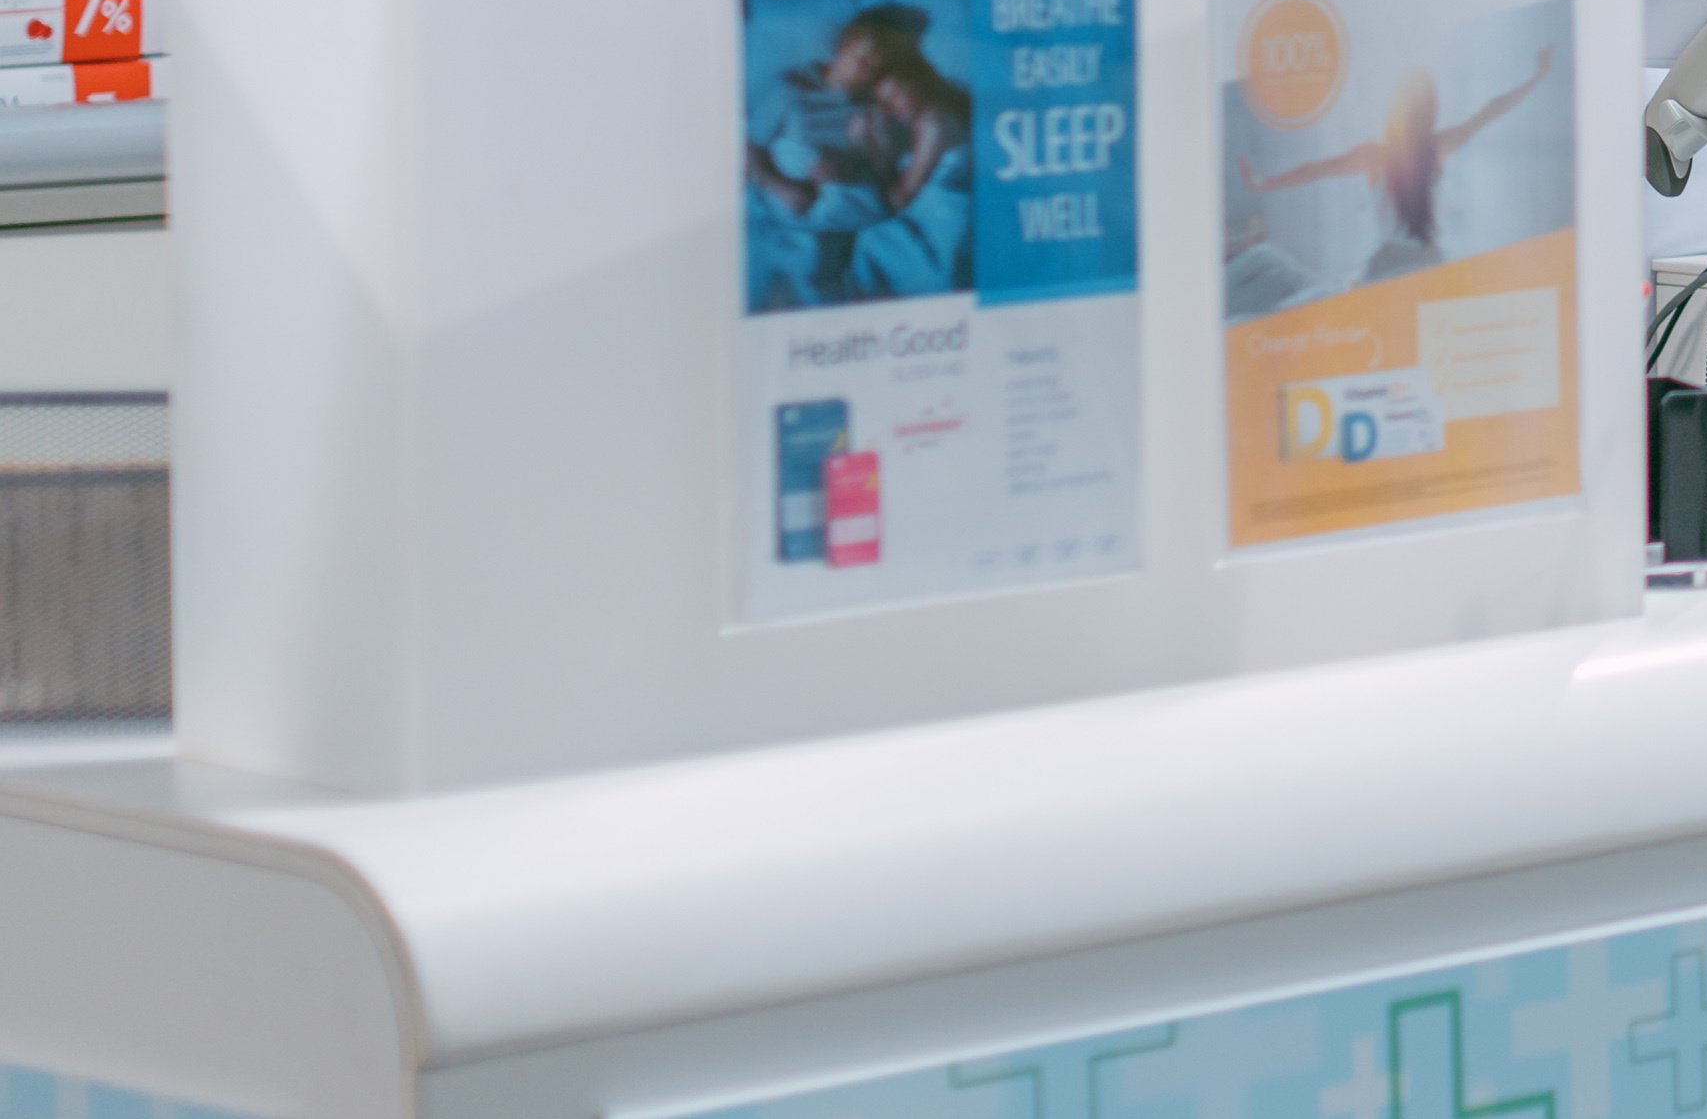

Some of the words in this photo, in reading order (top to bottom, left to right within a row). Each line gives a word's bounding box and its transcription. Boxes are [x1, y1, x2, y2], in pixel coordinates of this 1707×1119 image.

[1011, 44, 1102, 89] EASILY
[993, 103, 1124, 181] SLEEP
[1018, 193, 1103, 242] WELL
[788, 327, 882, 369] Health
[889, 320, 969, 359] Good
